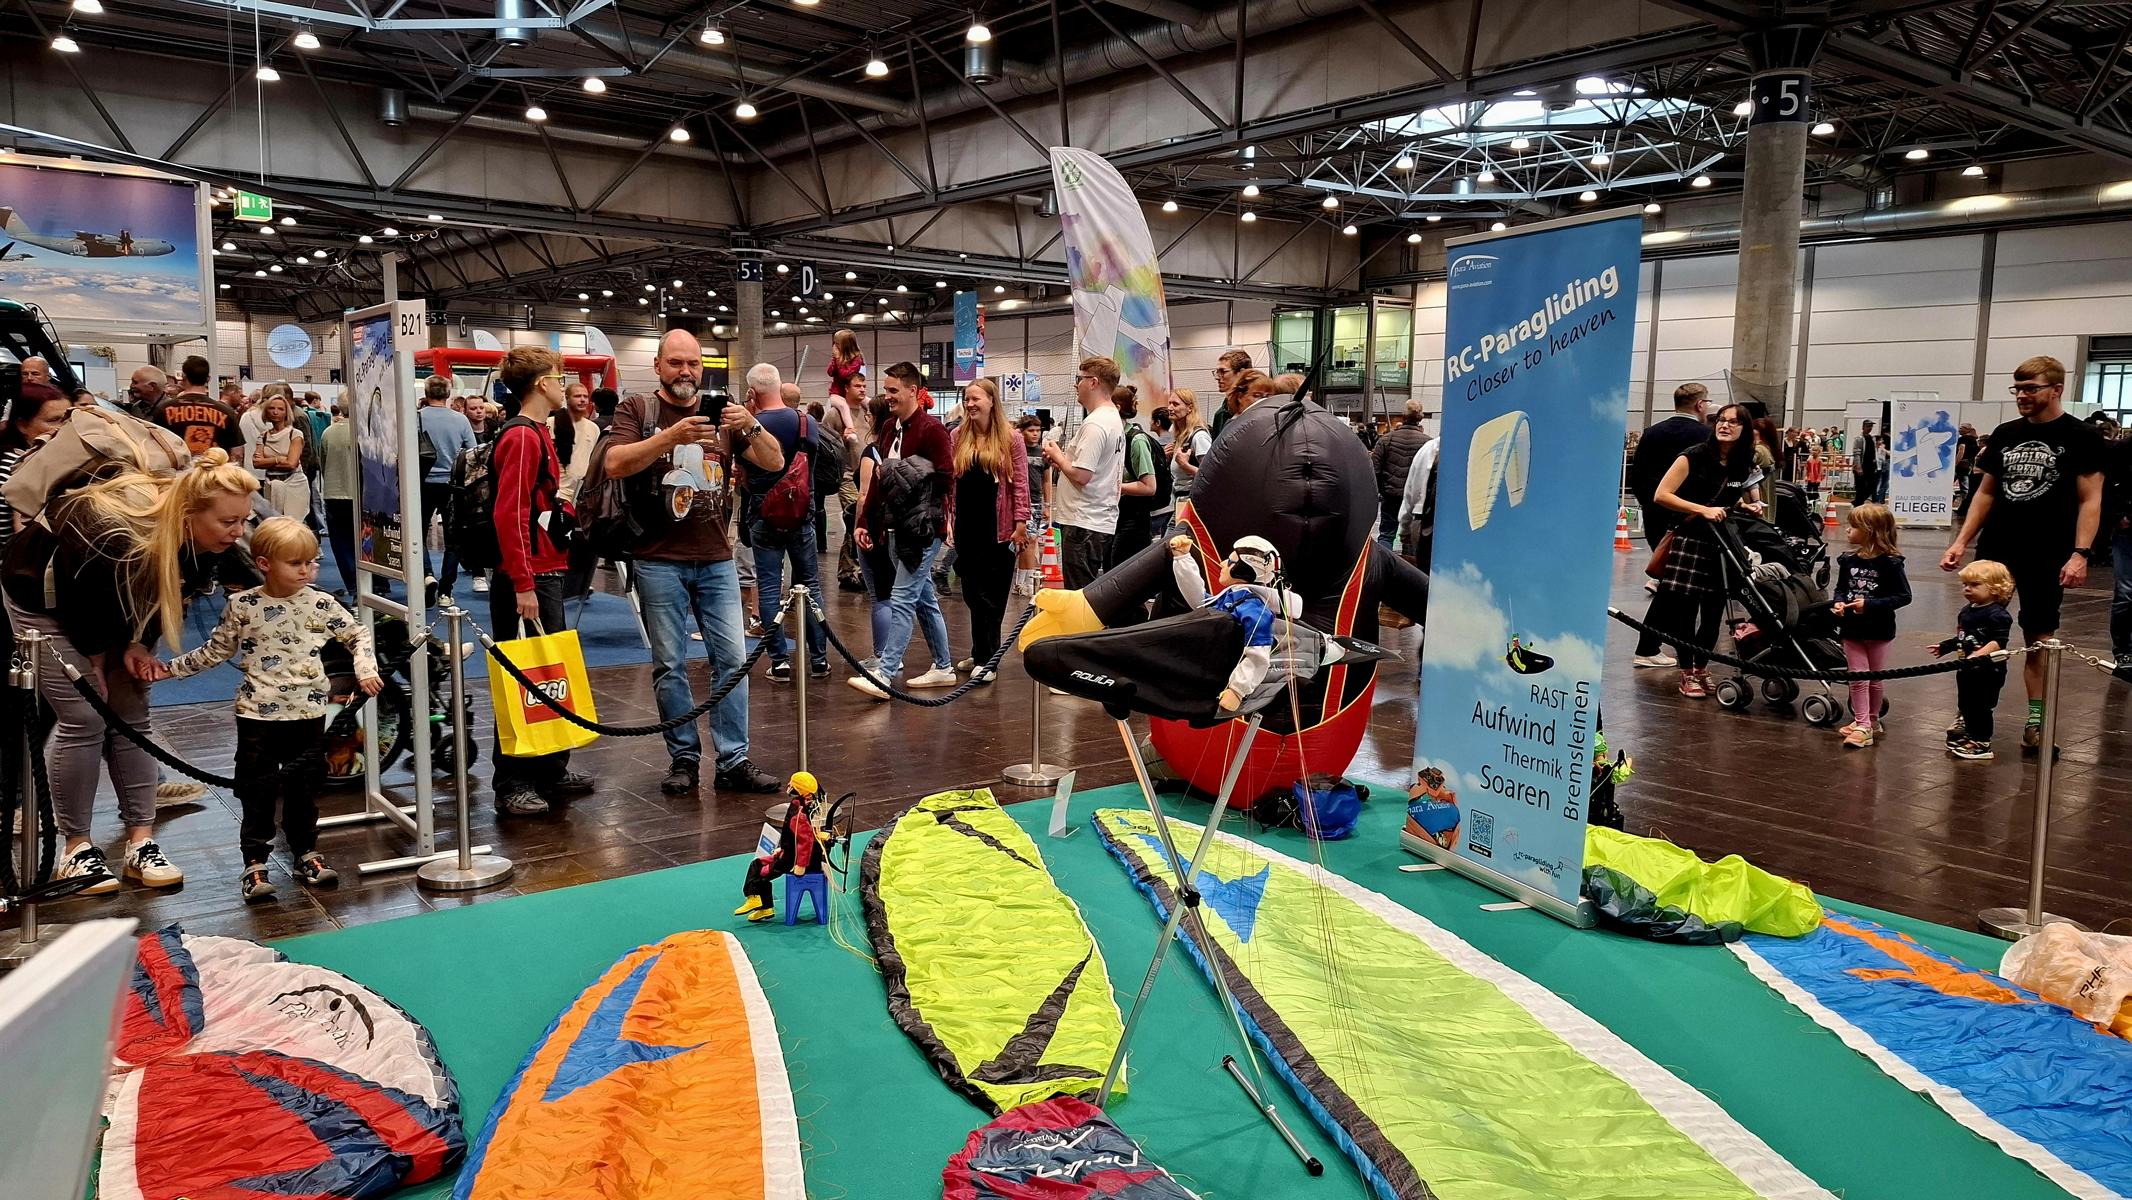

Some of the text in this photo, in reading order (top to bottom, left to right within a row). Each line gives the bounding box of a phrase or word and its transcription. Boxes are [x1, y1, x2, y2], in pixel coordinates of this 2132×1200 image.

[1779, 80, 1799, 116] 5
[741, 262, 750, 279] 5
[802, 266, 814, 295] D
[660, 287, 667, 312] E
[401, 313, 422, 336] B21
[460, 316, 466, 335] G
[528, 306, 534, 328] F
[1447, 265, 1619, 383] RC-Paragliding
[1467, 308, 1616, 401] Closer to heaven
[164, 405, 228, 429] PHOENIX
[2007, 463, 2045, 481] GREEN
[1894, 502, 1946, 513] FLIEGER
[1070, 670, 1115, 687] AQUILA
[1530, 684, 1569, 711] RAST
[1471, 700, 1556, 746] Aufwind
[1502, 743, 1563, 780] Thermik
[1563, 680, 1590, 821] Bremsleinen
[1480, 764, 1551, 811] Soaren
